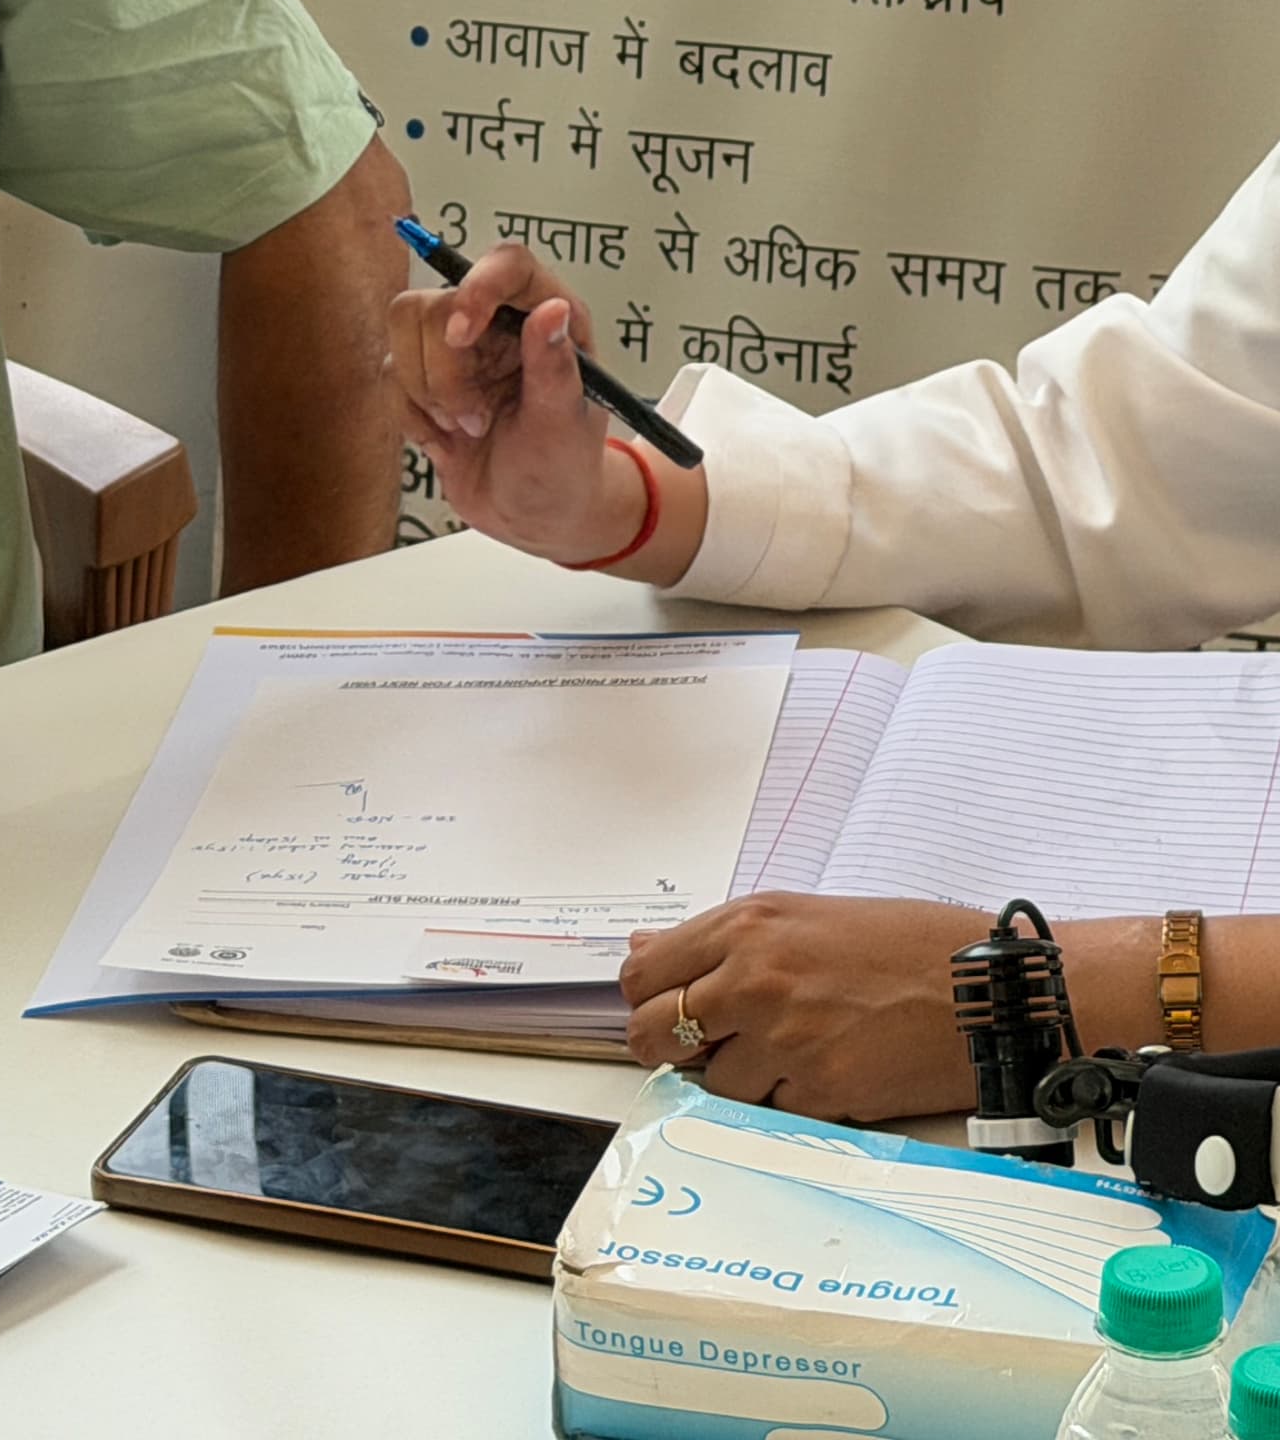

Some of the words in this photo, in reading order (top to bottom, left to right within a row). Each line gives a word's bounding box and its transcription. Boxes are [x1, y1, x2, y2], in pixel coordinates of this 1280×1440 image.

[446, 20, 589, 74] आवाज
[613, 17, 648, 80] में
[675, 40, 833, 97] बदलाव
[442, 98, 546, 164] गर्दन
[568, 107, 602, 170] में
[628, 131, 754, 195] सूजन
[438, 202, 468, 249] 3
[494, 212, 629, 270] सप्ताह
[654, 211, 699, 274] से
[725, 225, 860, 292] अधिक
[887, 253, 1007, 305] समय
[1032, 266, 1122, 311] तक
[616, 301, 653, 363] में
[679, 315, 858, 394] कठिनाई
[407, 895, 520, 906] PRESCRIPTION
[597, 1241, 805, 1292] Depressor
[818, 1278, 960, 1308] Tongue
[573, 1318, 685, 1358] Tongue
[699, 1339, 863, 1379] Depressor
